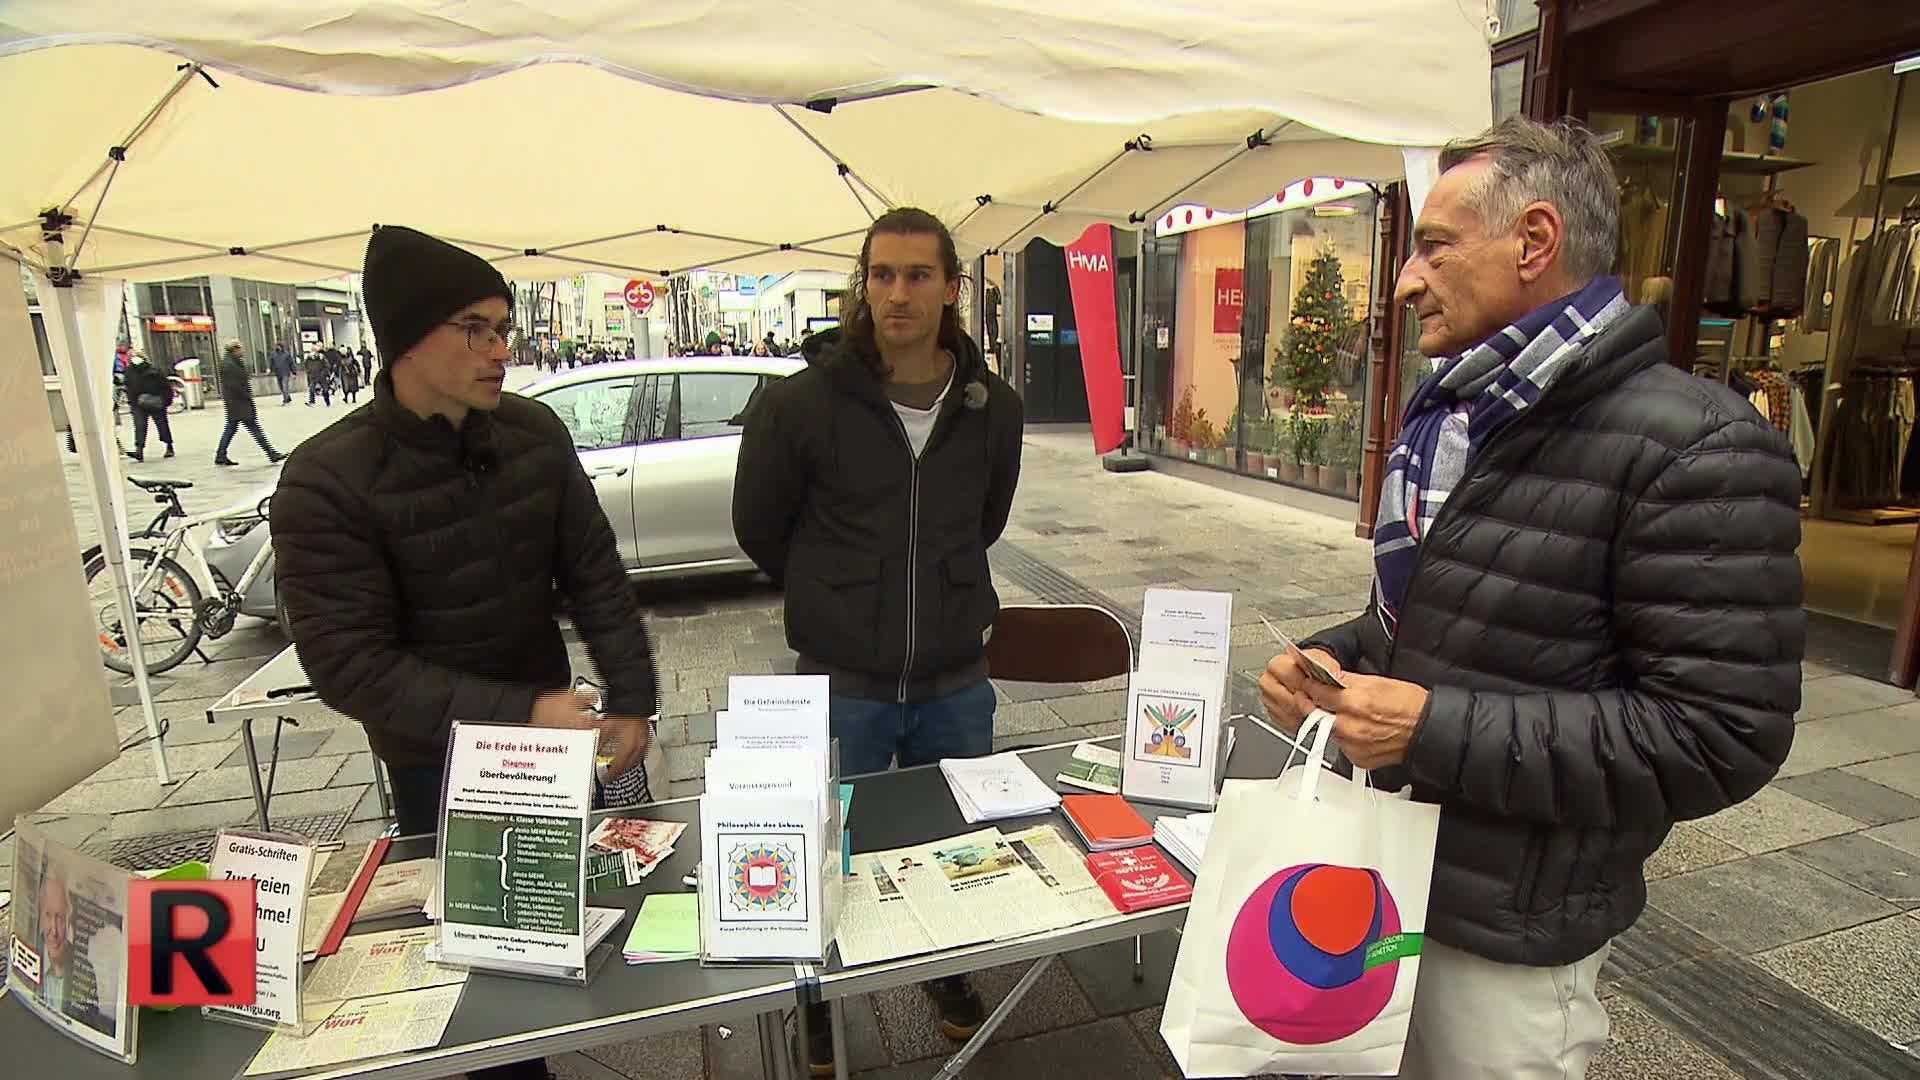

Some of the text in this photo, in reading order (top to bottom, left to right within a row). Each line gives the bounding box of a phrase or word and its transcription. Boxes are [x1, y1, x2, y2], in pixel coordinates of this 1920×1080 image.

[476, 741, 568, 754] Die Erde ist krank!
[479, 769, 557, 784] Überbevölkerung!
[717, 821, 761, 829] Philosophie
[778, 821, 804, 829] Lebens
[228, 842, 298, 861] Gratis-Schriften
[369, 944, 407, 957] Wort
[324, 1016, 366, 1030] Wort
